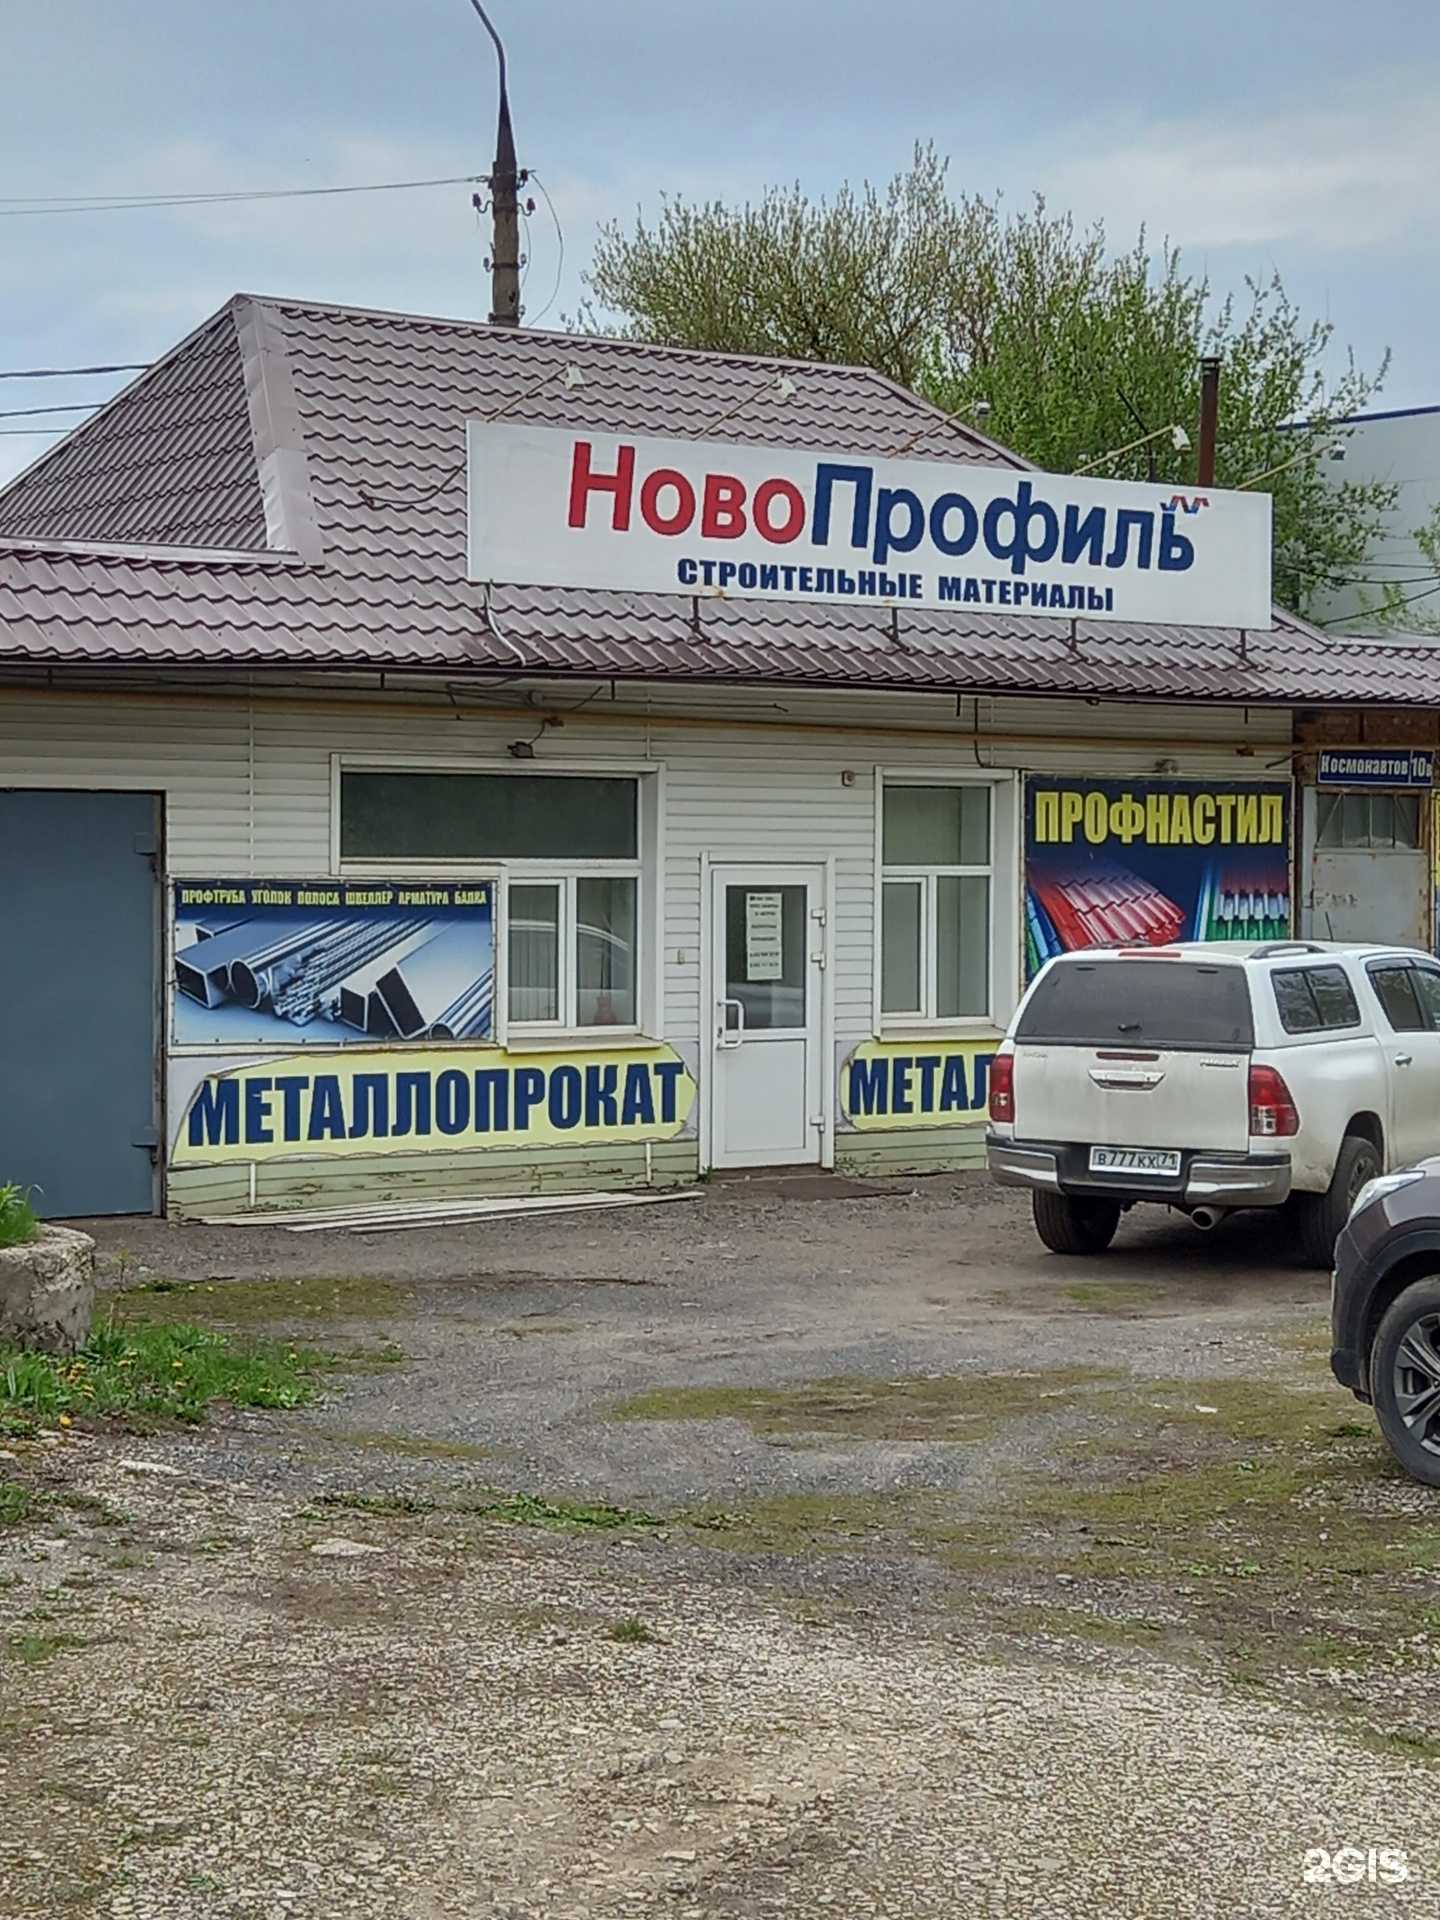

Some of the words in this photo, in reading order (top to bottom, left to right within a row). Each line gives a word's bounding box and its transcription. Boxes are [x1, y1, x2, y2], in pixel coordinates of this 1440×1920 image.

[568, 441, 1195, 574] НовоПрофиль
[677, 557, 924, 601] СТРОИТЕЛЬНЫЕ
[938, 575, 1114, 612] МАТЕРИАЛЫ
[1321, 755, 1409, 775] Космонавтов
[1034, 791, 1284, 845] ПРОФНАСТИЛ
[181, 889, 246, 904] ПРОФТРУБА
[252, 889, 292, 905] УГОЛОК
[297, 890, 340, 905] ПОЛОСА
[345, 890, 393, 905] ШВЕЛЛЕР
[398, 890, 449, 905] АРМАТУРА
[454, 890, 487, 905] БАЛКА
[188, 1061, 685, 1148] МЕТАЛЛОПРОКАТ
